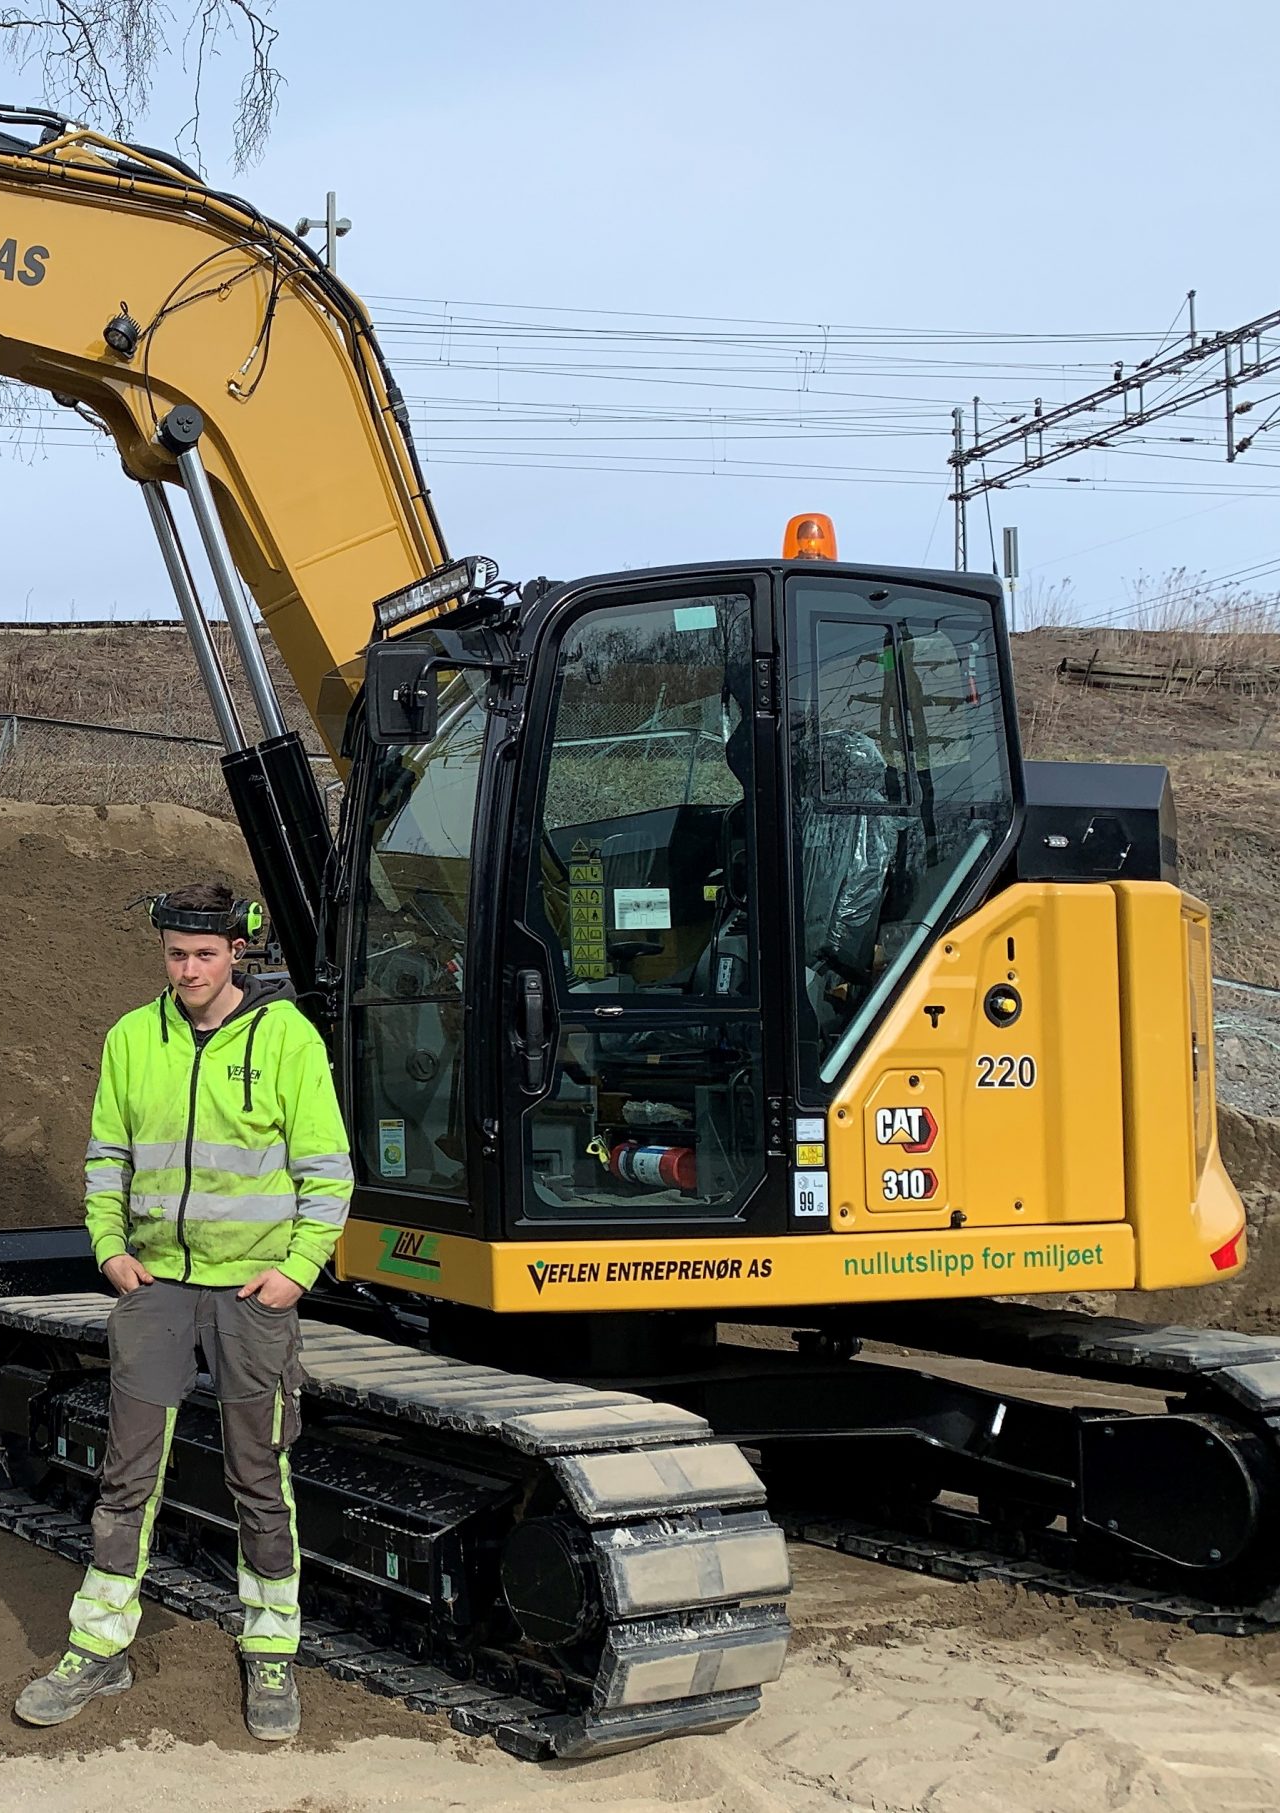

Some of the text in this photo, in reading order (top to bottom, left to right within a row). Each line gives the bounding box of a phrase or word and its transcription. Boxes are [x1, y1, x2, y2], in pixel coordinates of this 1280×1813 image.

[227, 1064, 262, 1082] VEFEN
[976, 1055, 1036, 1088] 220
[876, 1107, 923, 1144] CAT
[883, 1168, 926, 1200] 310
[800, 1191, 814, 1212] 99
[527, 1257, 773, 1296] VEFLEN ENTREPRENØR AS
[843, 1243, 1104, 1278] nullutslipp for miljøet
